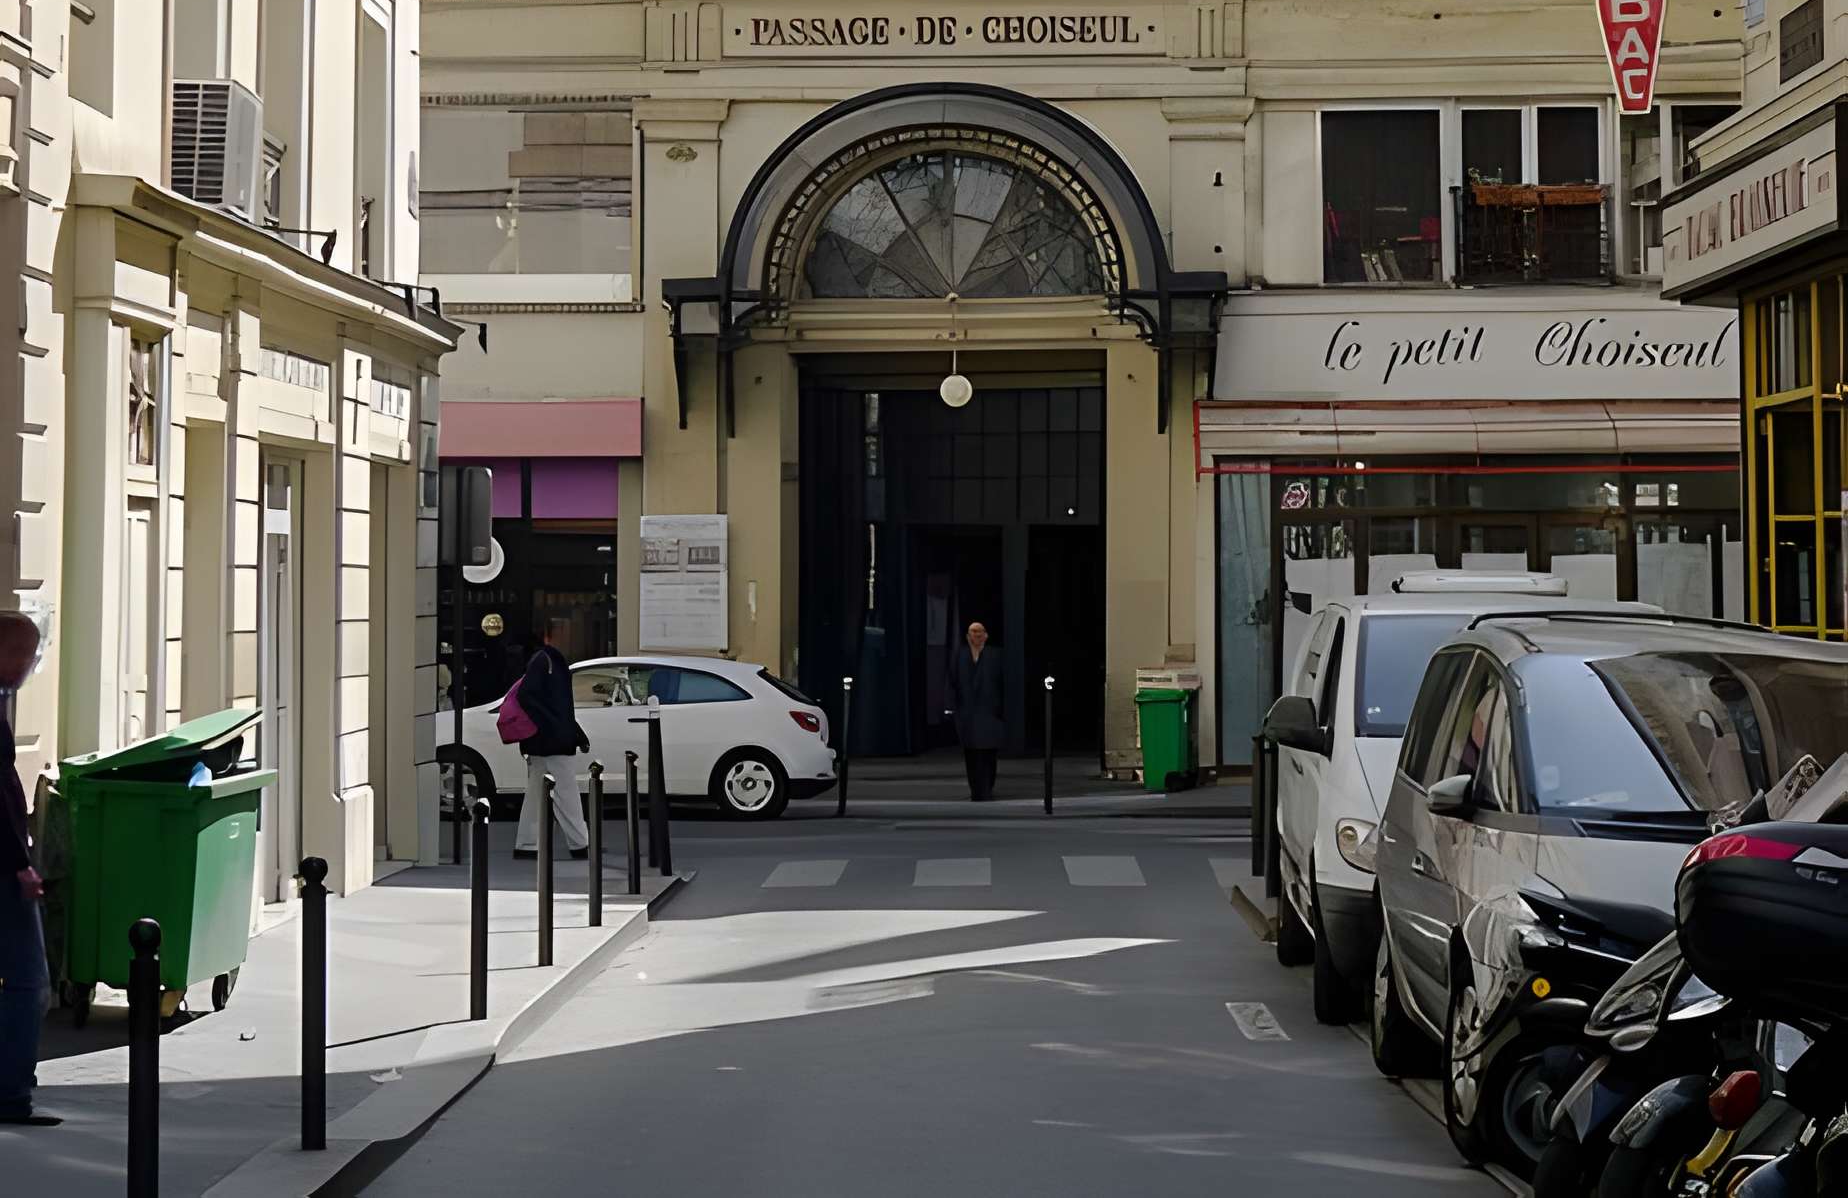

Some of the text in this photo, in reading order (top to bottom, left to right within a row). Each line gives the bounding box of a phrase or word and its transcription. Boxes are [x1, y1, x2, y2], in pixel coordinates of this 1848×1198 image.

[750, 15, 1140, 46] PASSAGE DE CHOISEUL
[1324, 315, 1738, 385] le petit Choiseul
